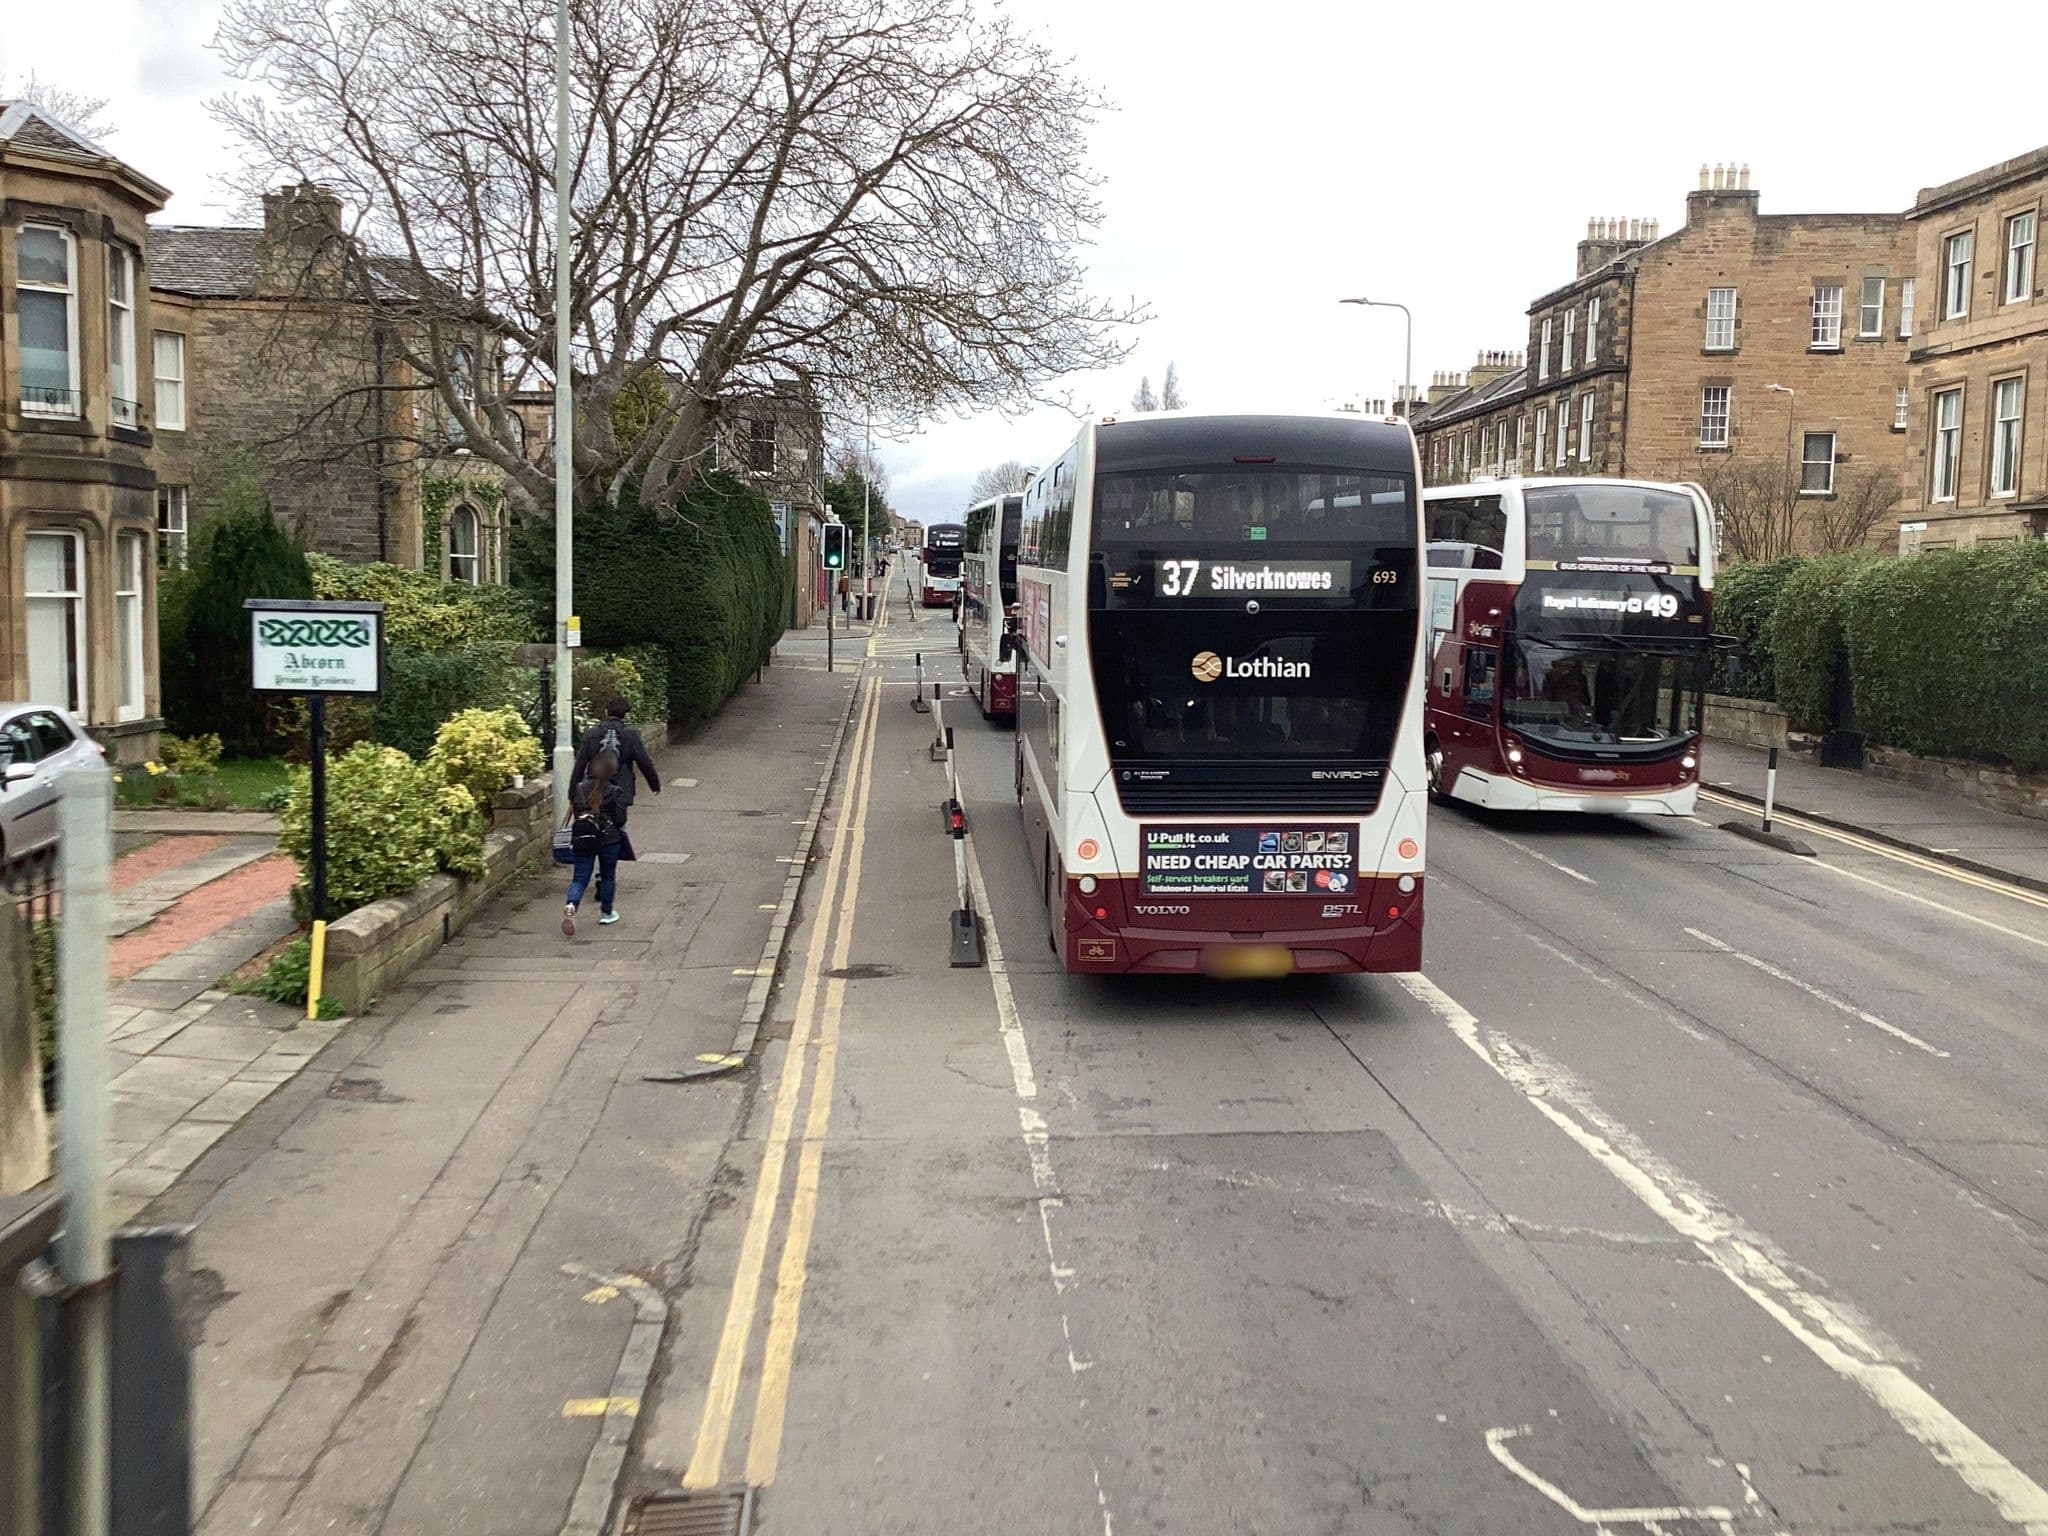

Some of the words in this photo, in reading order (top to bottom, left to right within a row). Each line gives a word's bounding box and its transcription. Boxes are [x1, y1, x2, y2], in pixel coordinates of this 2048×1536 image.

[1162, 561, 1200, 596] 37
[1211, 566, 1332, 590] Silverknowes
[1372, 571, 1397, 584] 693
[1544, 595, 1577, 609] Royal
[1577, 597, 1627, 612] Infirmary
[1644, 594, 1678, 617] 49
[1226, 656, 1311, 678] Lothian
[1147, 855, 1192, 870] NEED
[1194, 855, 1250, 870] CHEAP
[1252, 855, 1288, 869] CAR
[1290, 854, 1353, 869] PARTS?
[1147, 875, 1193, 883] Self-service
[1193, 875, 1229, 883] breakers
[1230, 875, 1249, 885] yard
[1134, 905, 1191, 915] VOLVO
